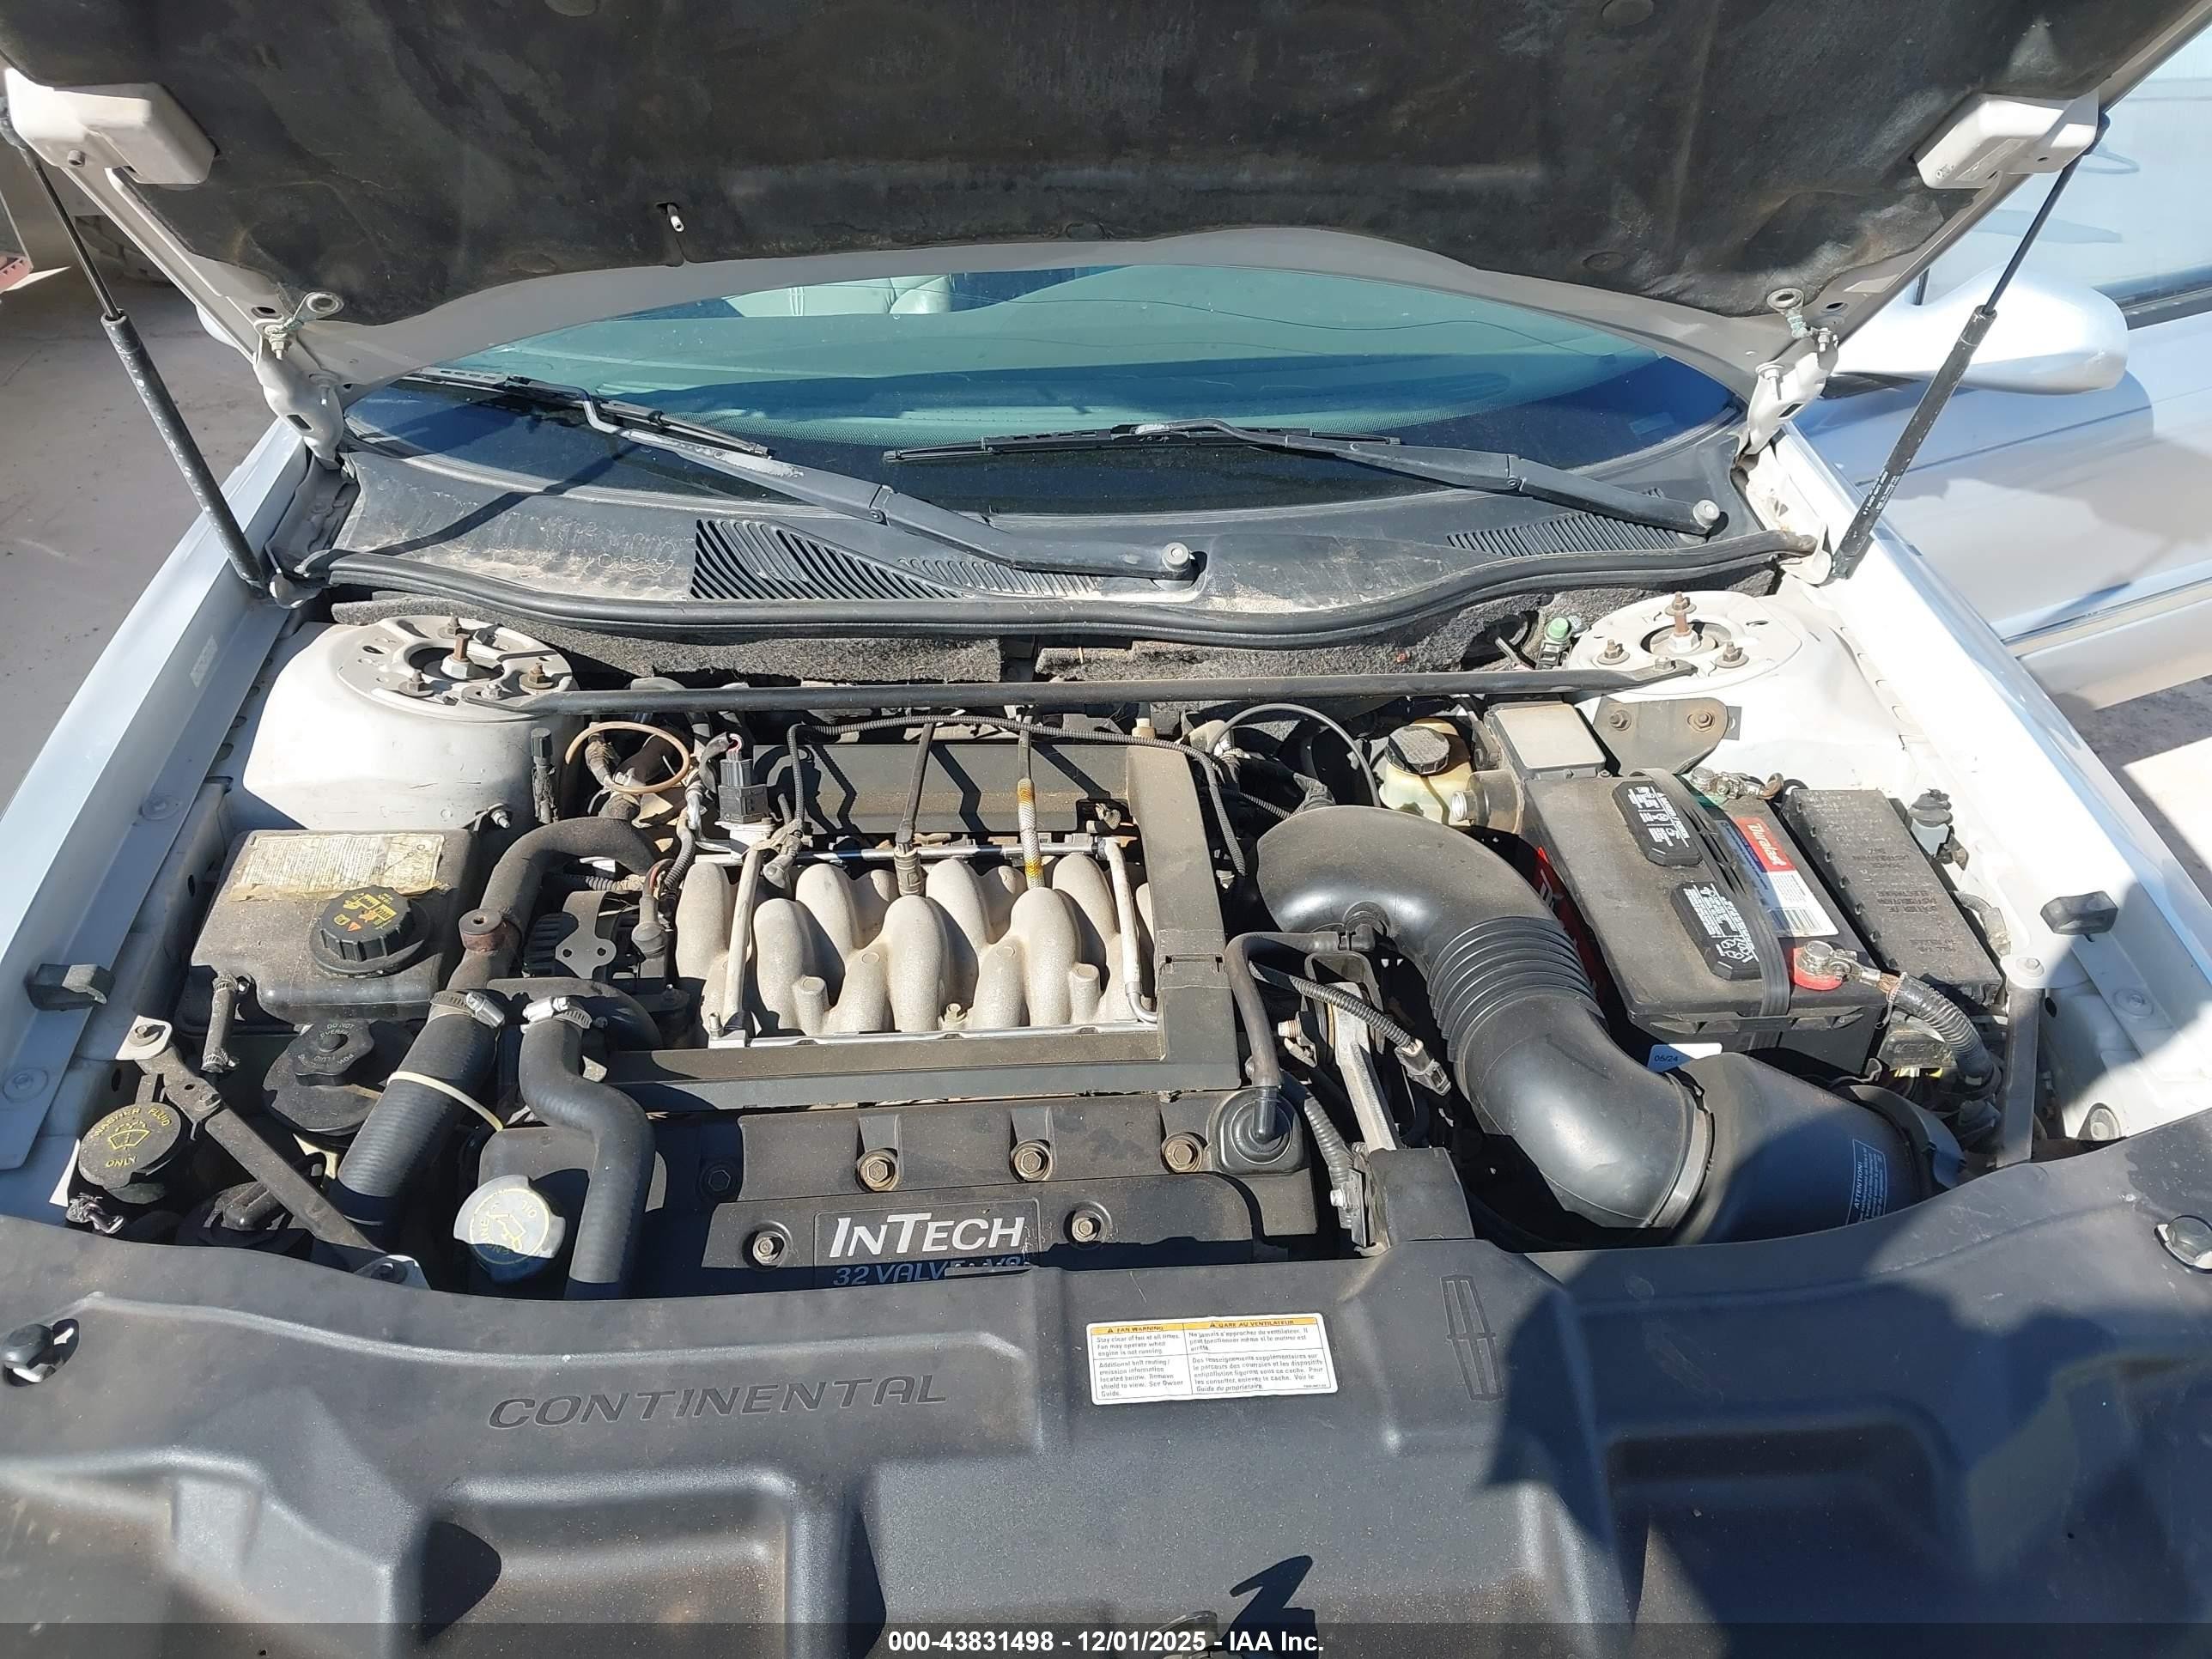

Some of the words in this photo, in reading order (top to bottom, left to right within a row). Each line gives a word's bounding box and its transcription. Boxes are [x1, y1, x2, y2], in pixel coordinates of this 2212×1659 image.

[1747, 823, 1787, 866] Duralast
[94, 1107, 142, 1137] WASHER
[148, 1107, 173, 1127] FLUID
[105, 1155, 137, 1168] ONLY
[1854, 1161, 1863, 1210] ATTENTION!
[521, 1200, 538, 1219] OIL
[833, 1266, 870, 1286] 32
[488, 1373, 947, 1430] CONTINENTAL
